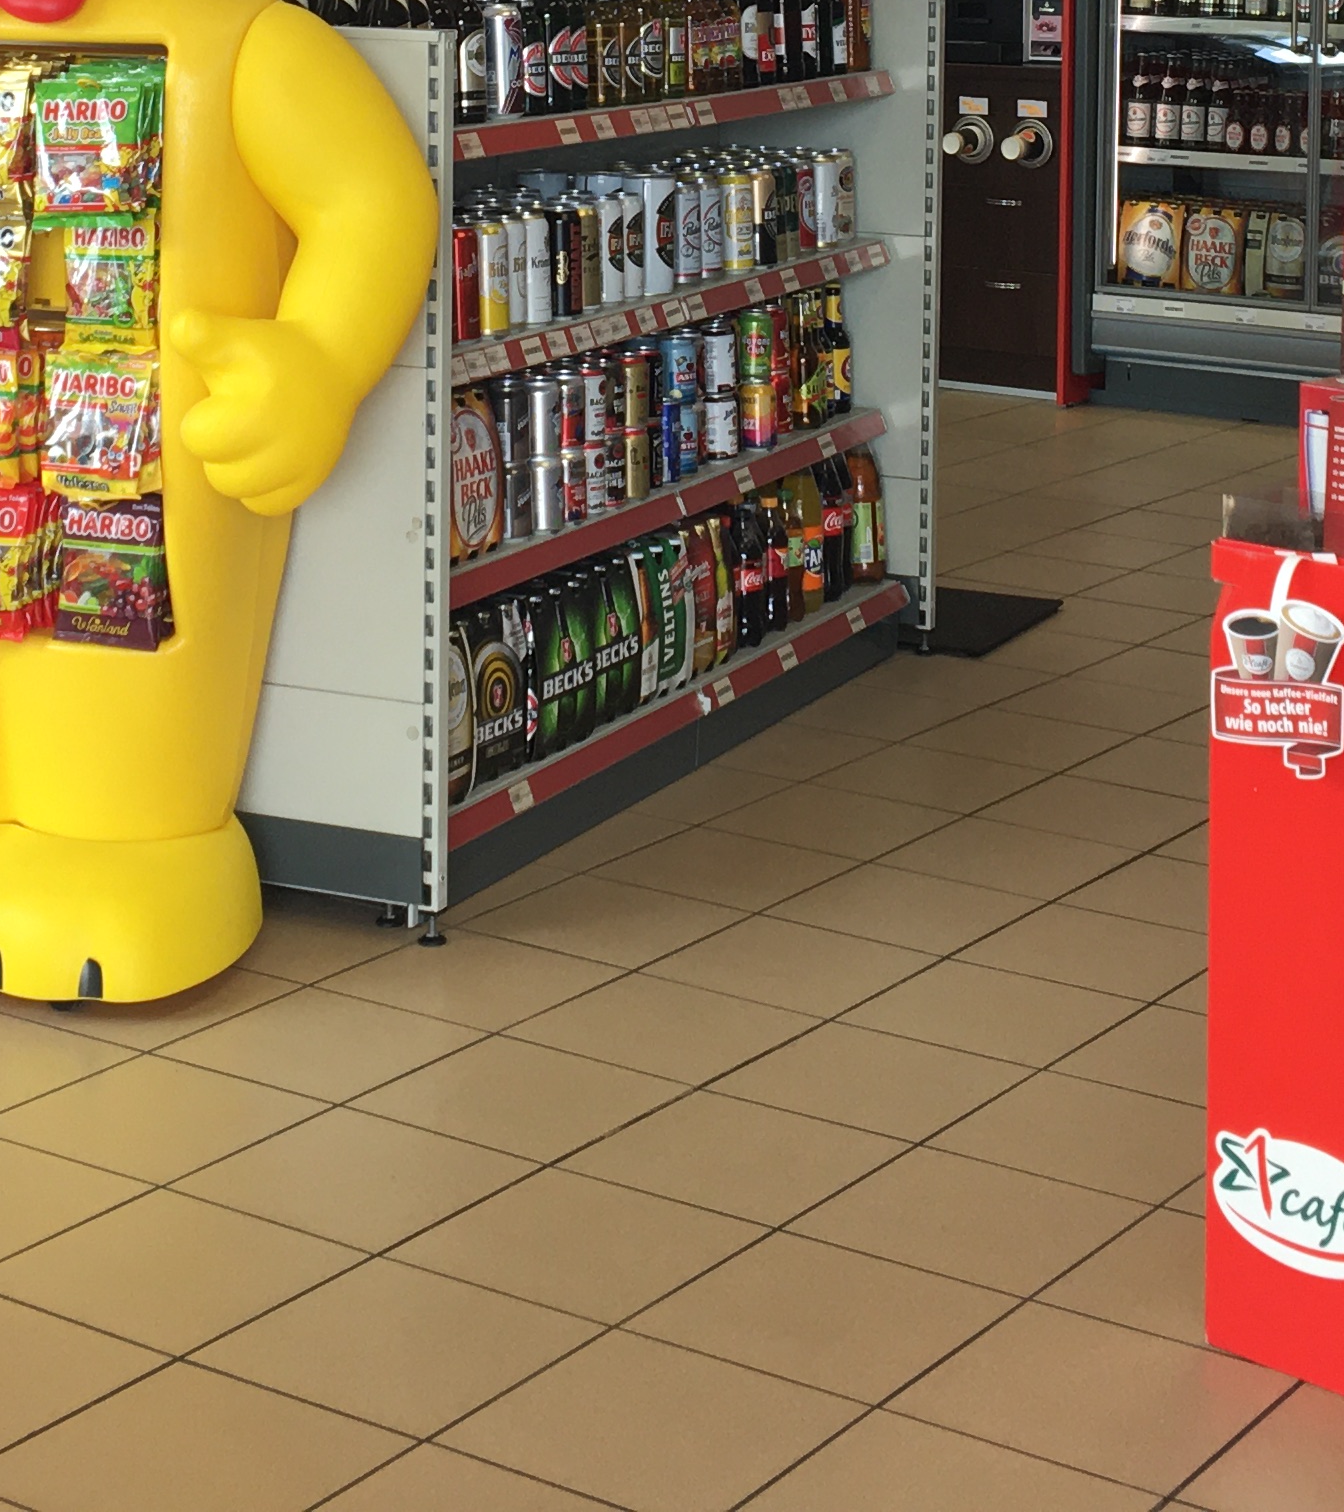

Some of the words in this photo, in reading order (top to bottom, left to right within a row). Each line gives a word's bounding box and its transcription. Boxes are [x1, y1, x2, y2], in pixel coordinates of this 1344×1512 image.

[44, 100, 127, 122] HARIBO
[73, 228, 147, 248] HARIBO
[1191, 238, 1235, 255] HAAKE
[1194, 253, 1229, 269] BECK
[1195, 262, 1222, 282] Pils
[53, 372, 136, 399] HARIBO
[453, 448, 497, 482] HAAKE
[461, 476, 494, 507] BECK
[463, 495, 487, 529] Pils
[68, 513, 152, 540] HARIBO
[72, 616, 131, 636] Weinland
[658, 569, 675, 662] VELTINS
[542, 660, 594, 700] BECK'S
[1221, 683, 1249, 697] Unsere
[1250, 689, 1272, 699] neue
[1273, 687, 1338, 705] Kaffee-Vielfalt
[1244, 699, 1261, 715] So
[1265, 699, 1311, 716] lecker
[476, 709, 523, 743] BECK'S
[1225, 715, 1253, 732] wie
[1258, 717, 1294, 733] noch
[1298, 717, 1328, 737] nie!
